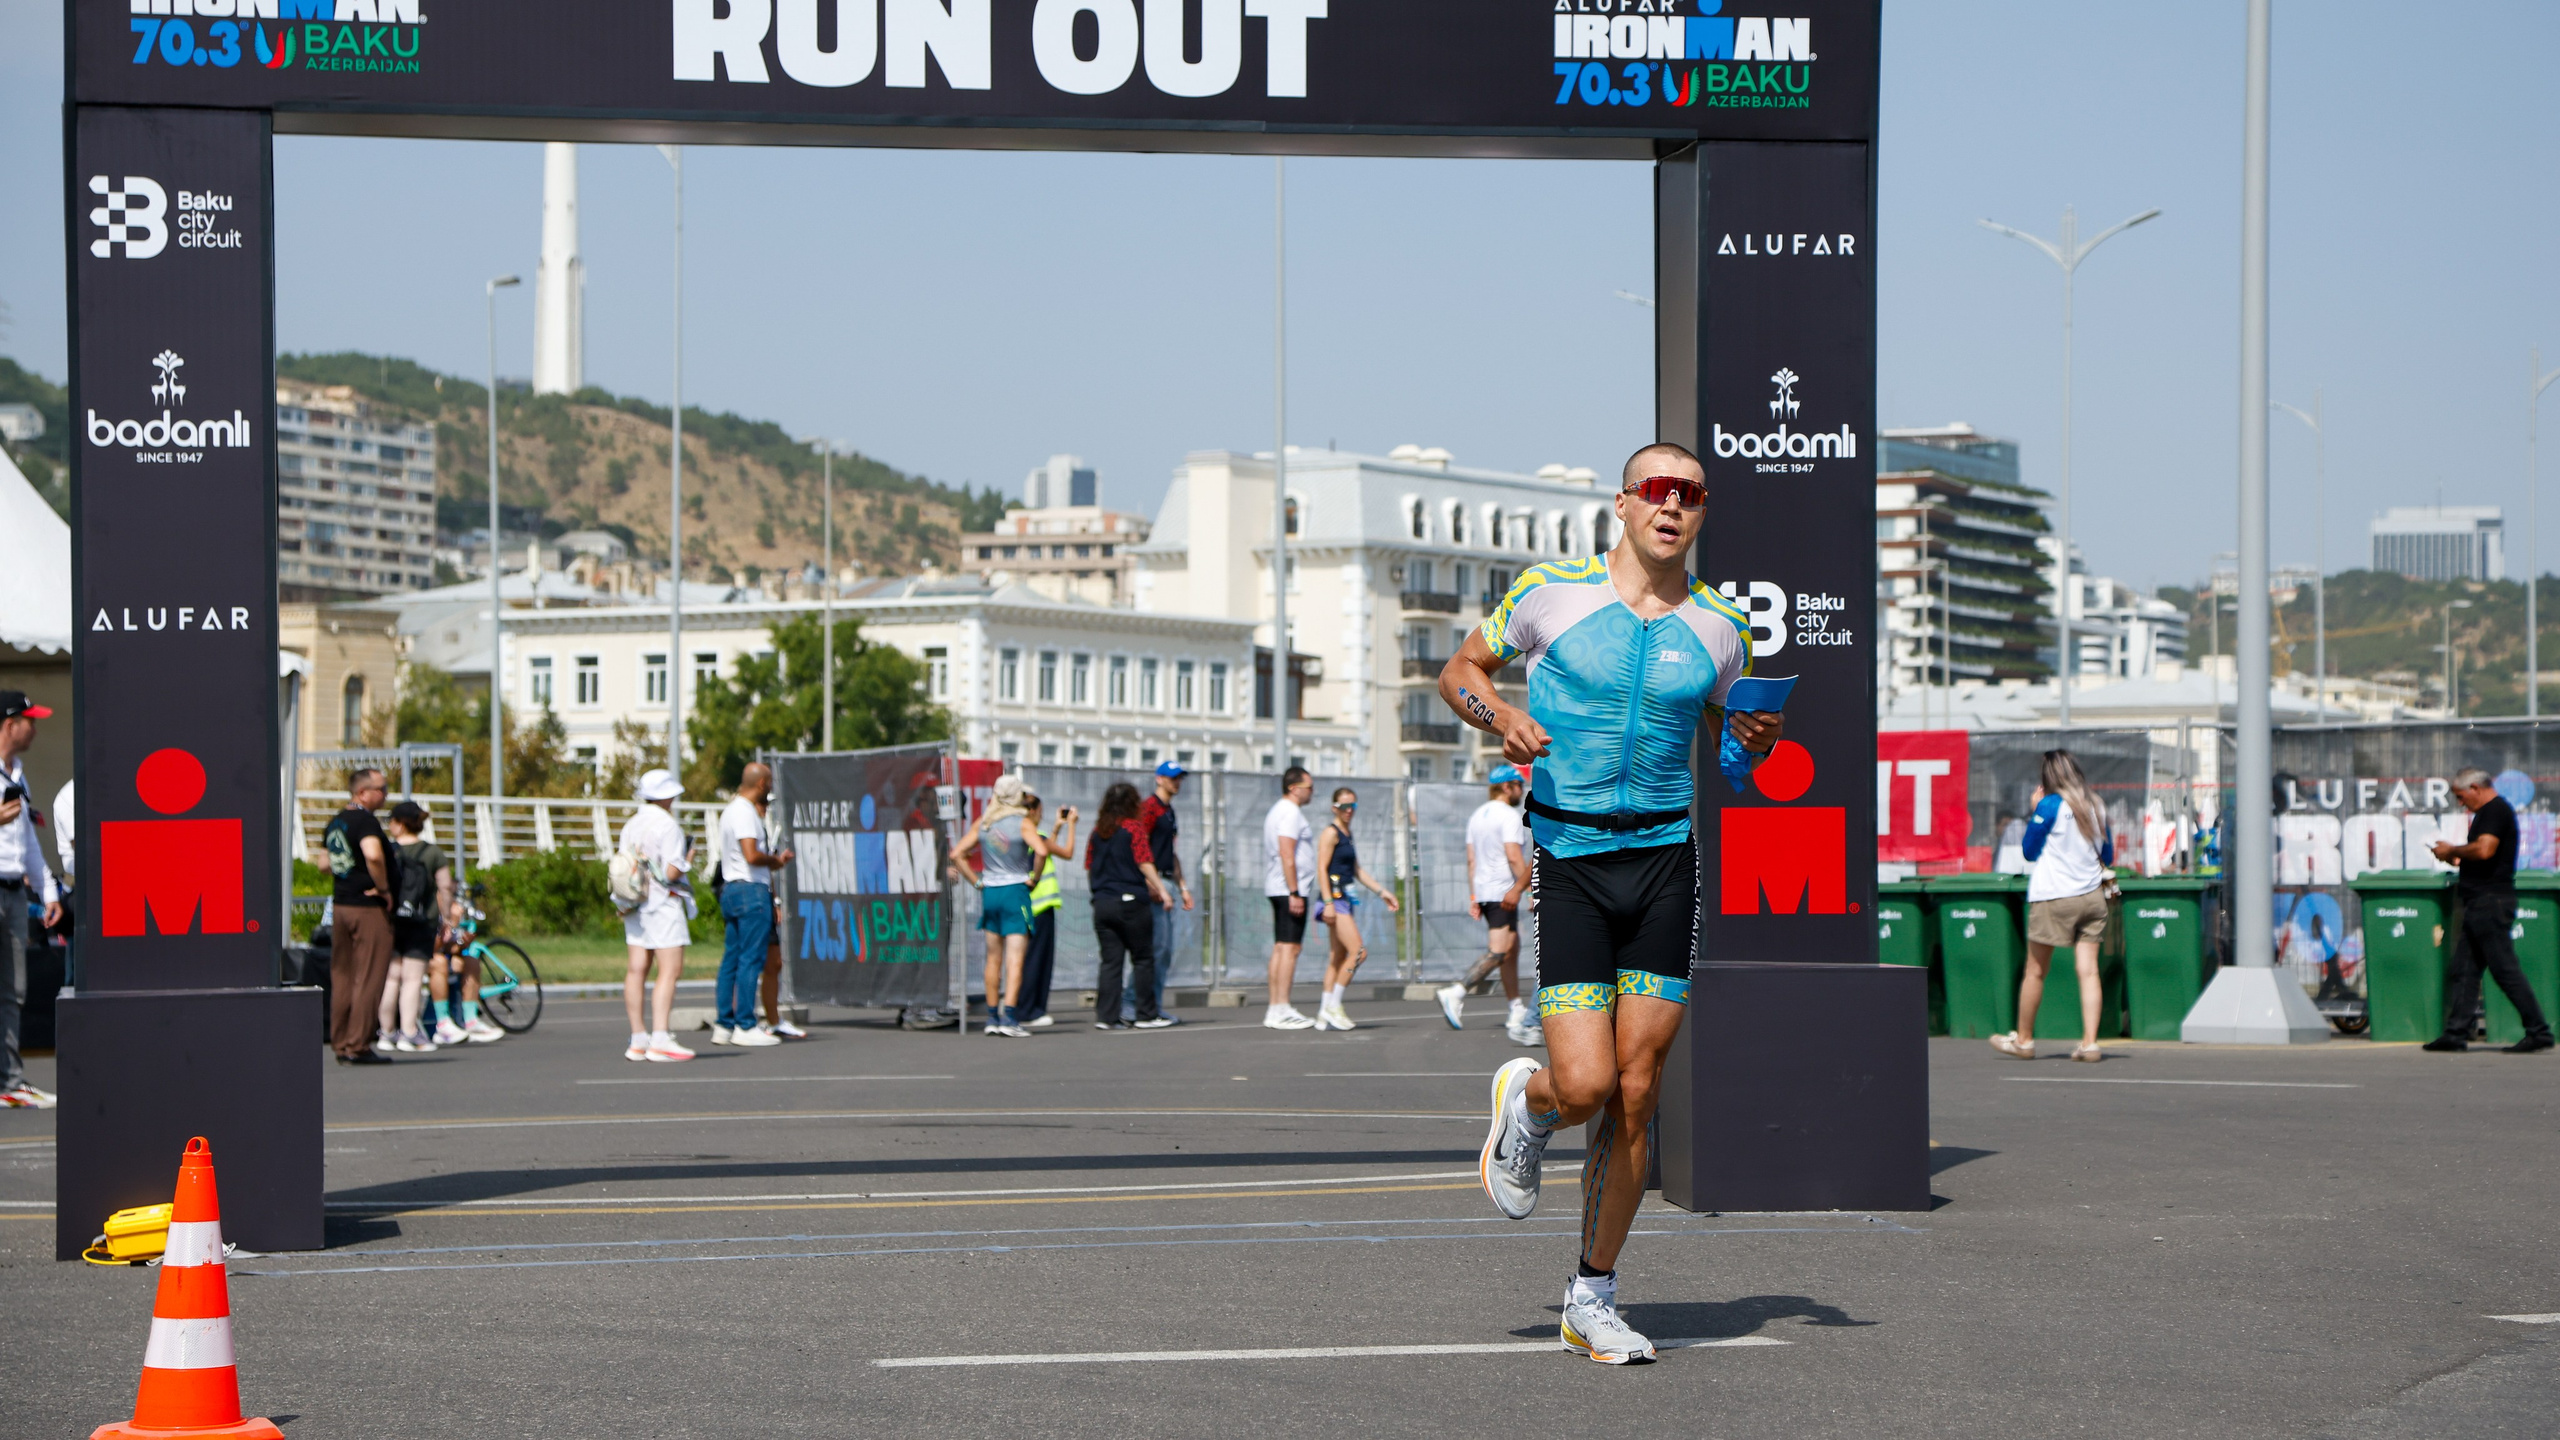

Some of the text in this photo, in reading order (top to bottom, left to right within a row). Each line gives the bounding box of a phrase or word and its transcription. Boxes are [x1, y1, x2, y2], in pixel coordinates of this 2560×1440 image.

[130, 18, 242, 68] 70.3
[304, 23, 420, 58] BAKU
[673, 0, 1328, 98] RUN OUT
[1554, 14, 1811, 61] IRONMAN
[305, 57, 420, 74] AZERBAIJAN
[1553, 62, 1651, 107] 70.3
[1706, 64, 1810, 93] BAKU
[1707, 95, 1810, 109] AZERBAIJAN
[177, 190, 233, 211] Baku
[177, 210, 216, 233] city
[178, 229, 242, 248] circuit
[1717, 233, 1856, 255] ALUFAR
[135, 452, 204, 464] SINCE 1947
[1755, 463, 1815, 473] SINCE 1947
[1796, 592, 1846, 611] Baku
[91, 606, 250, 631] ALUFAR
[1796, 611, 1830, 633] city
[1796, 629, 1853, 646] circuit
[2273, 778, 2449, 809] LUFAR
[793, 801, 851, 828] ALUFAR
[793, 829, 938, 894] IRONMAN
[798, 899, 847, 963] 70.3
[871, 900, 940, 942] BAKU
